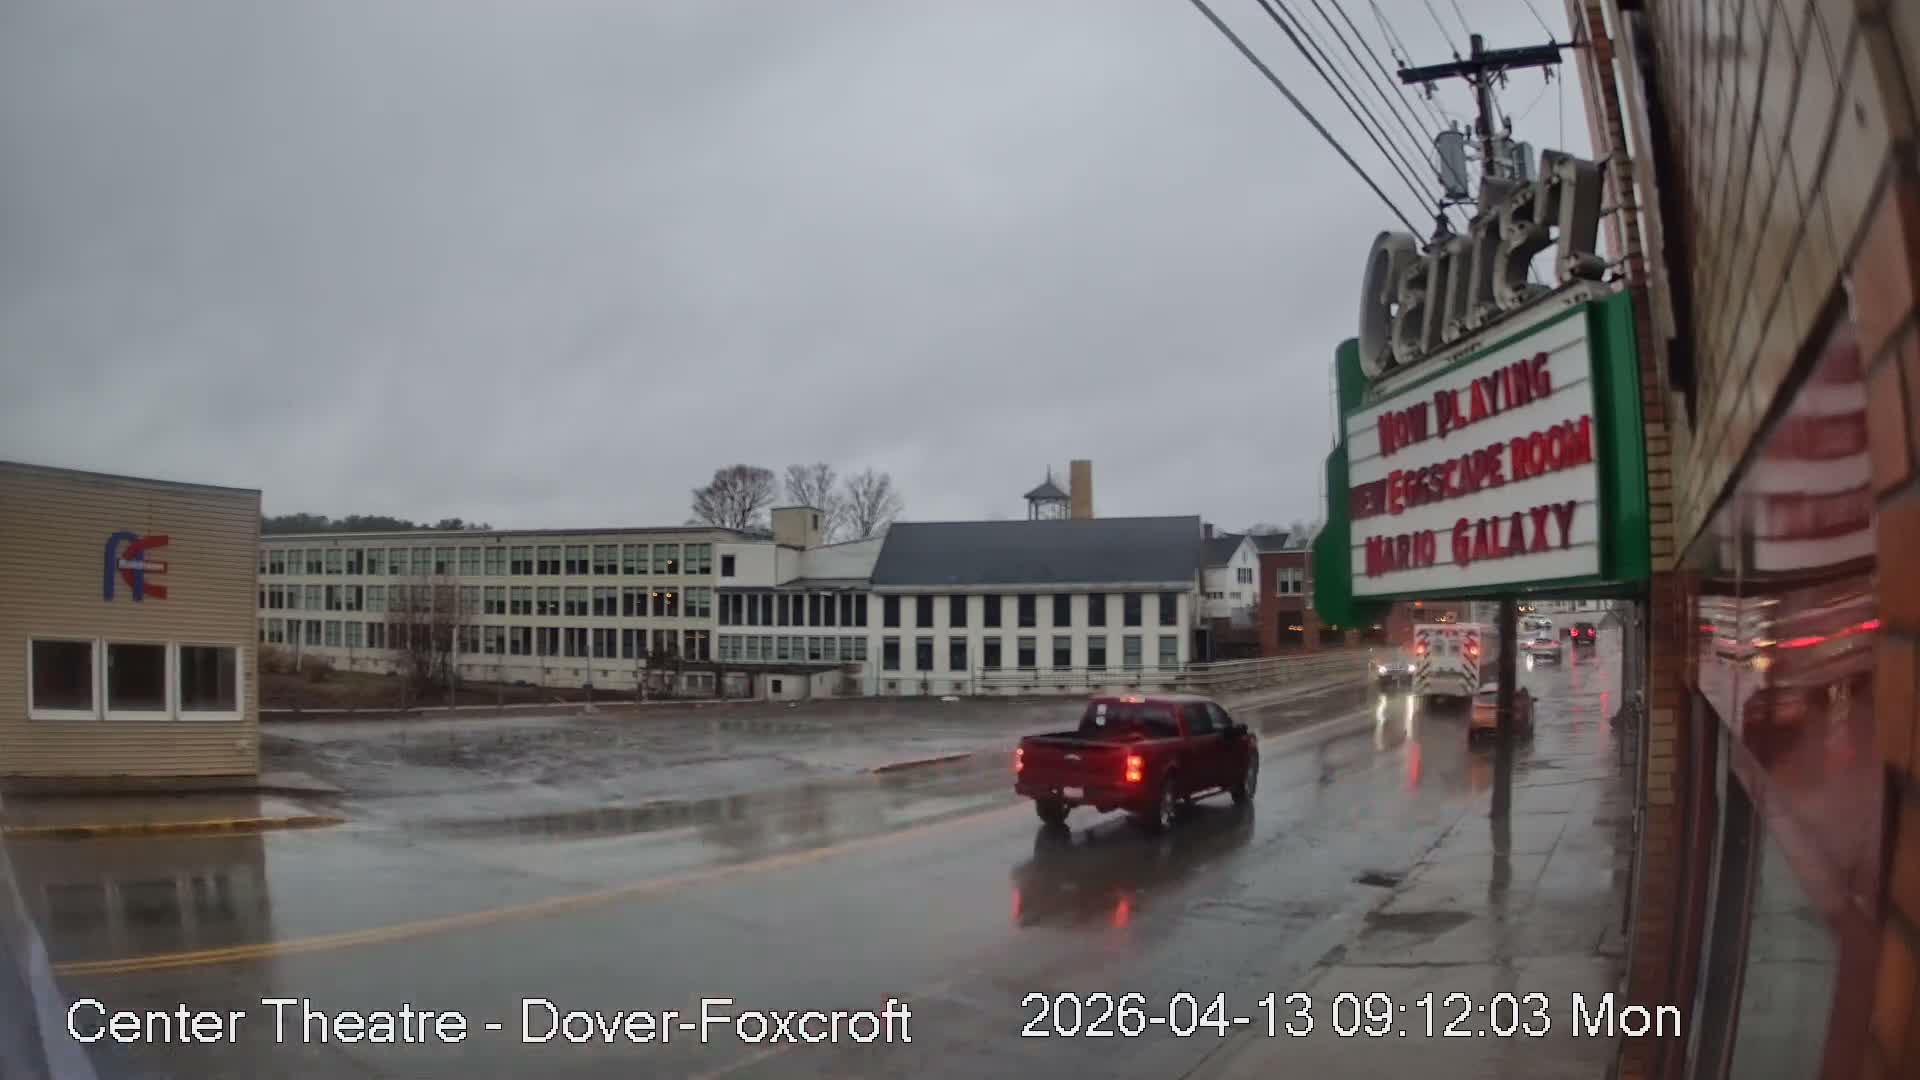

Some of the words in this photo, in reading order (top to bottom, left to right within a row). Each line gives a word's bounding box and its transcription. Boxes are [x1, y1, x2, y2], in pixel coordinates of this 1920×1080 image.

[1377, 402, 1428, 458] NOW
[1434, 352, 1552, 439] PLAYING
[1386, 443, 1504, 516] EGGSCAPE
[1510, 415, 1593, 482] ROOM
[1365, 530, 1436, 577] MARIO
[1452, 500, 1577, 567] GALAXY
